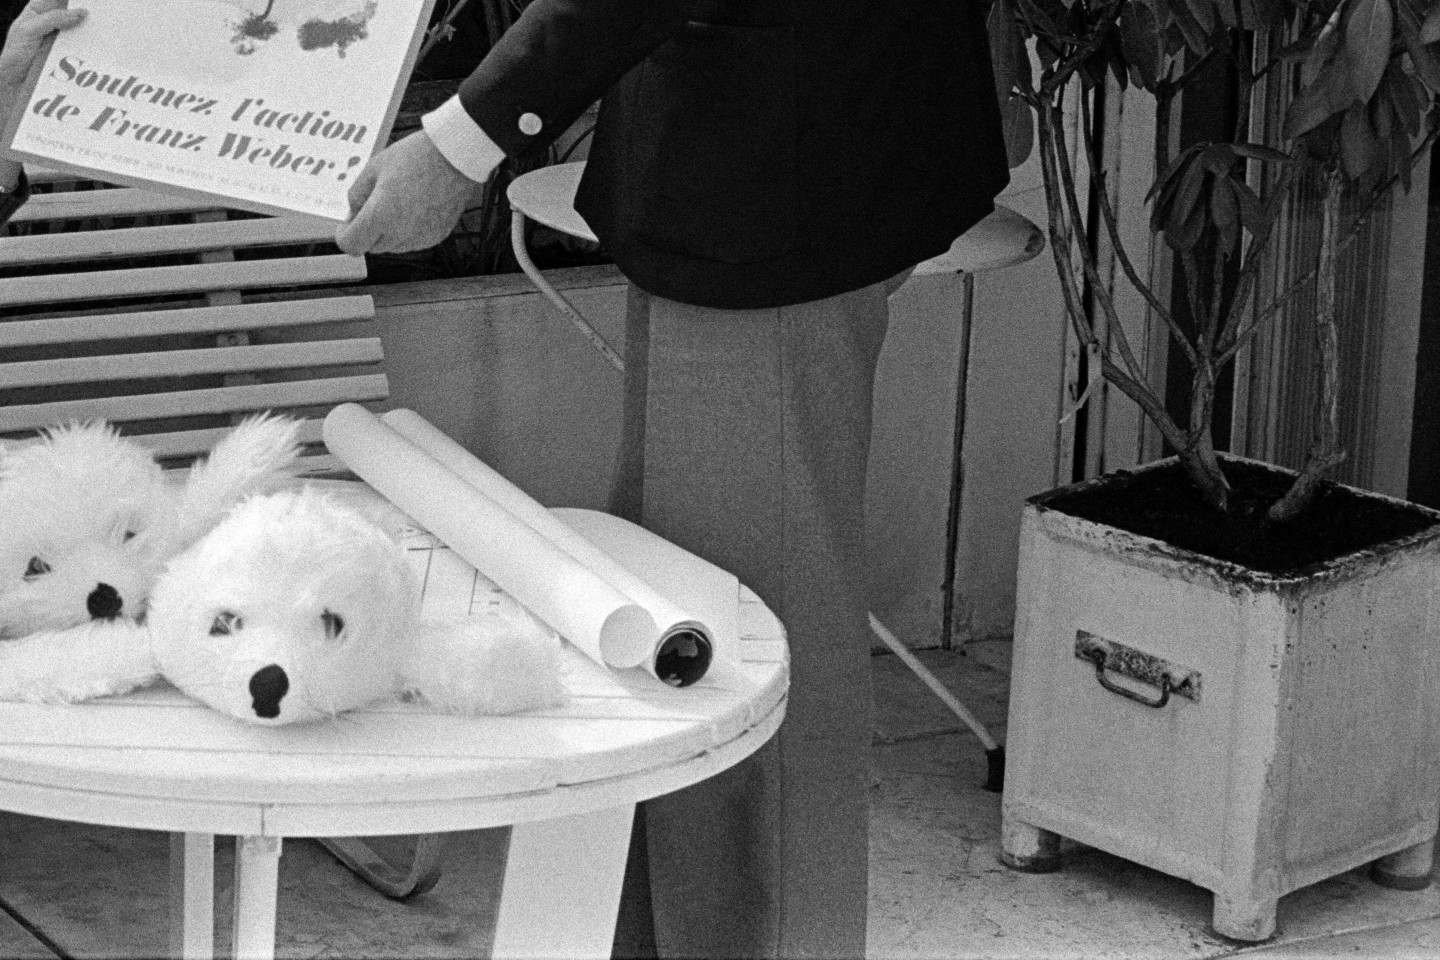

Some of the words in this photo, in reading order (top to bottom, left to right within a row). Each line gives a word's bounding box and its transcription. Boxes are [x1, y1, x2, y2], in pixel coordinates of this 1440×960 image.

[32, 92, 81, 121] de
[89, 106, 207, 152] Franz
[48, 54, 218, 115] Soutenez
[231, 98, 367, 144] l'action
